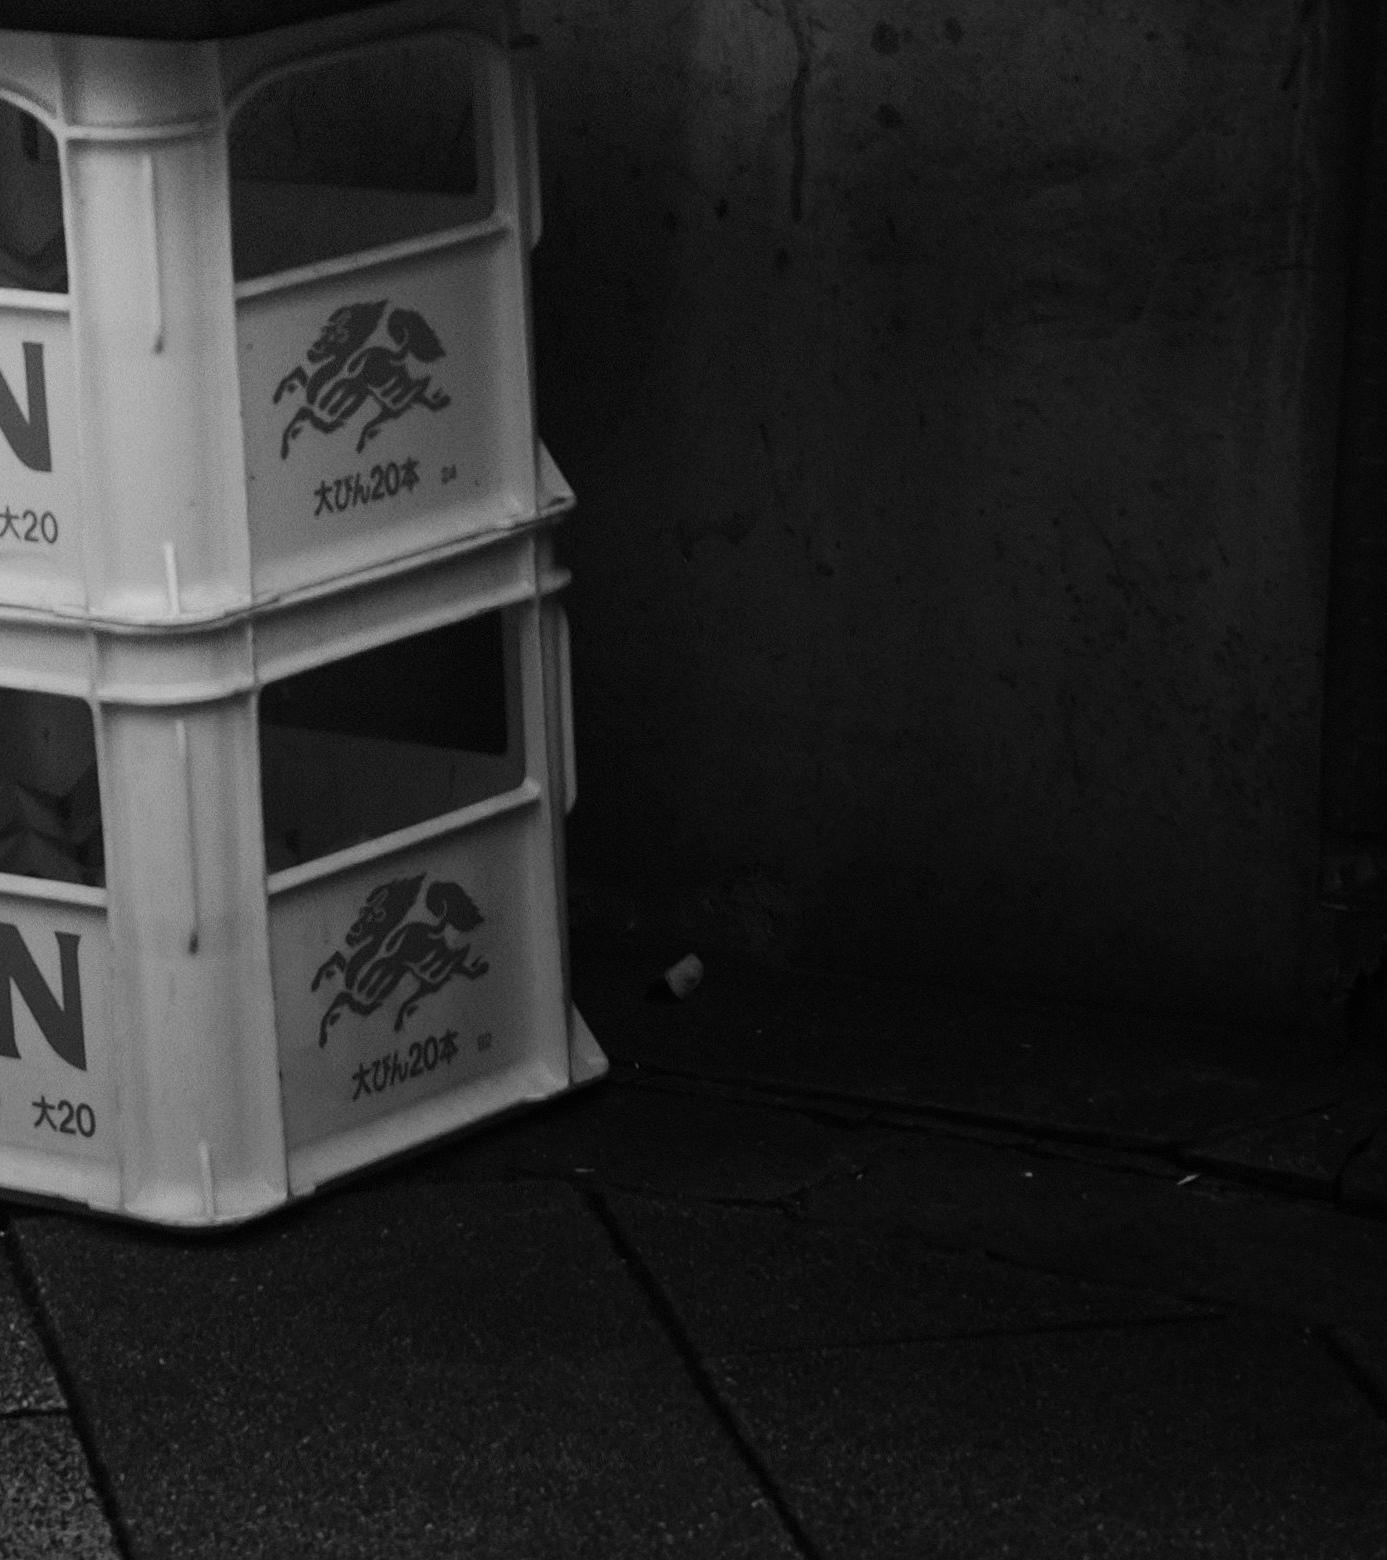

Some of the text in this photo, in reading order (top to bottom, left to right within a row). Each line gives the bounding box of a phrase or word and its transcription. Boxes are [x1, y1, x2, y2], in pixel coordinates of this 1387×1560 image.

[312, 457, 420, 517] 大びん20本
[349, 1027, 460, 1103] 大びん20本
